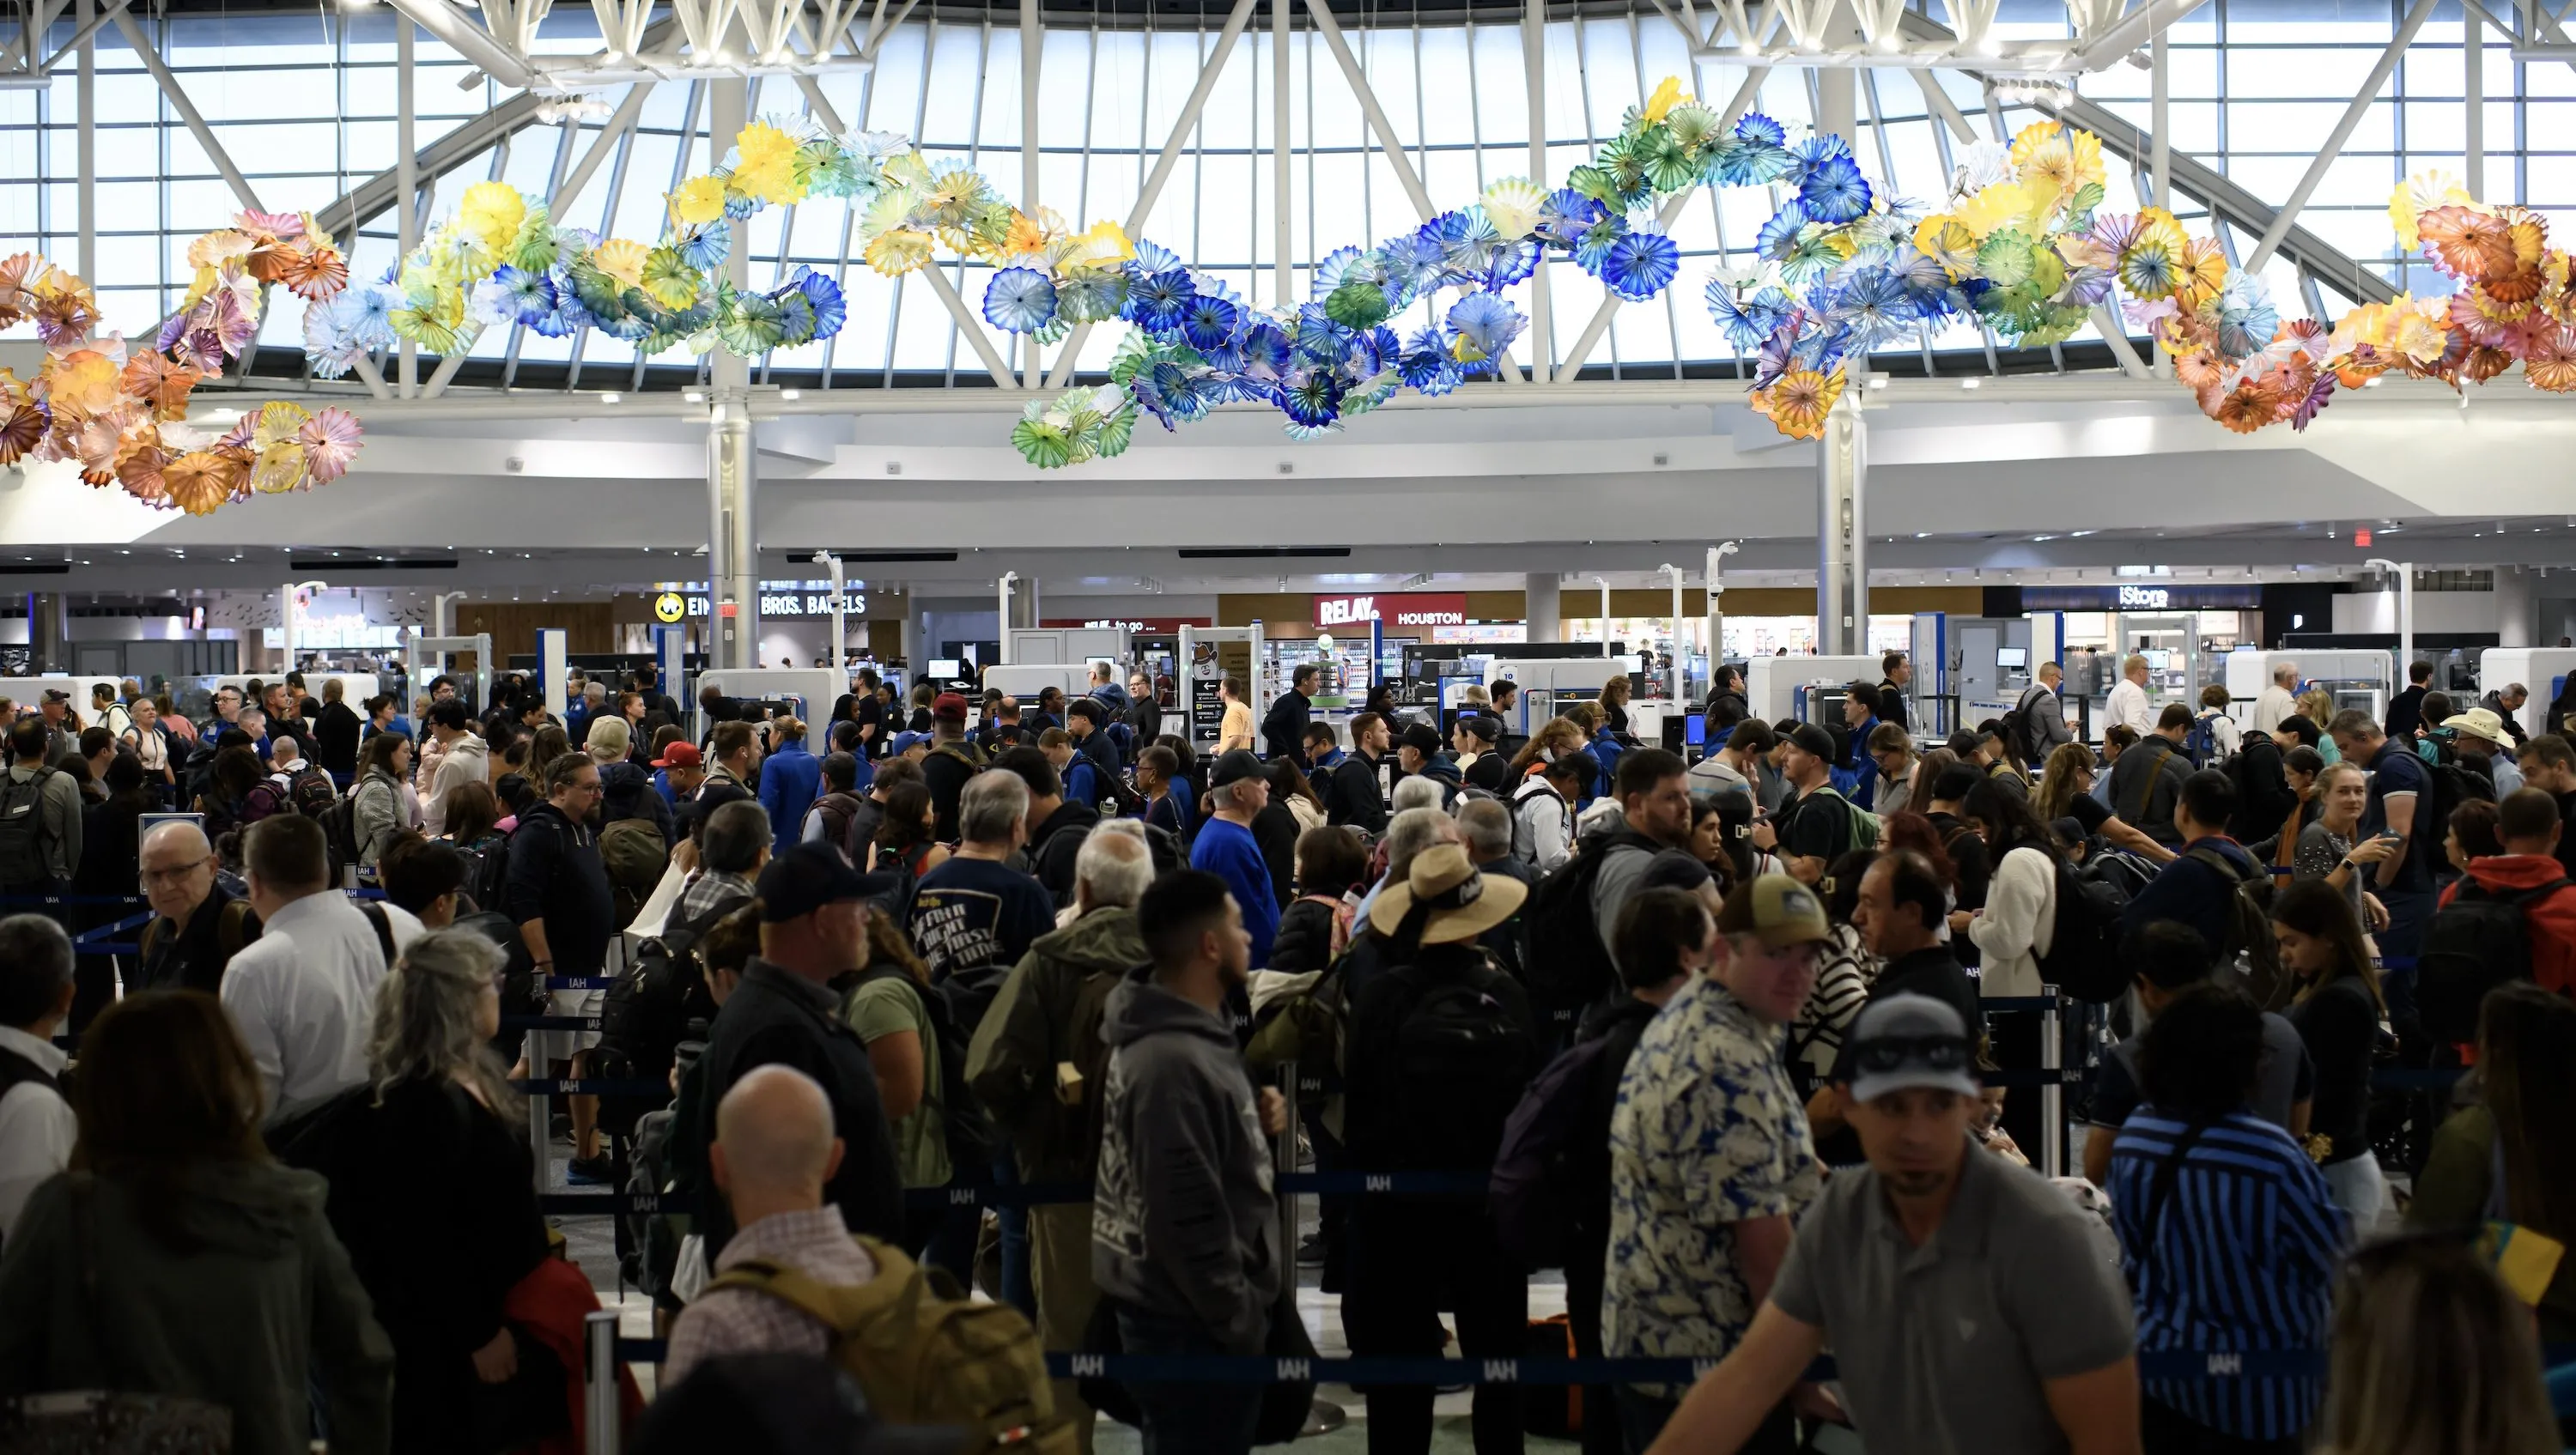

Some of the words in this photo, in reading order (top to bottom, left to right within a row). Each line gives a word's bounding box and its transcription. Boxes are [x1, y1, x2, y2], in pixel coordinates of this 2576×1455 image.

[2119, 586, 2168, 604] iStore
[761, 596, 803, 615] BROS.
[1129, 621, 1143, 633] go
[1398, 612, 1462, 625] HOUSTON
[568, 978, 587, 988] IAH
[1553, 1009, 1571, 1021] IAH
[559, 1079, 580, 1092] IAH
[1300, 1077, 1321, 1091] IAH
[1365, 1174, 1392, 1192] IAH
[633, 1195, 659, 1212] IAH
[949, 1187, 975, 1205] IAH
[1071, 1354, 1104, 1377] IAH
[1276, 1356, 1311, 1381] IAH
[1483, 1357, 1518, 1382] IAH
[2207, 1352, 2243, 1376] IAH
